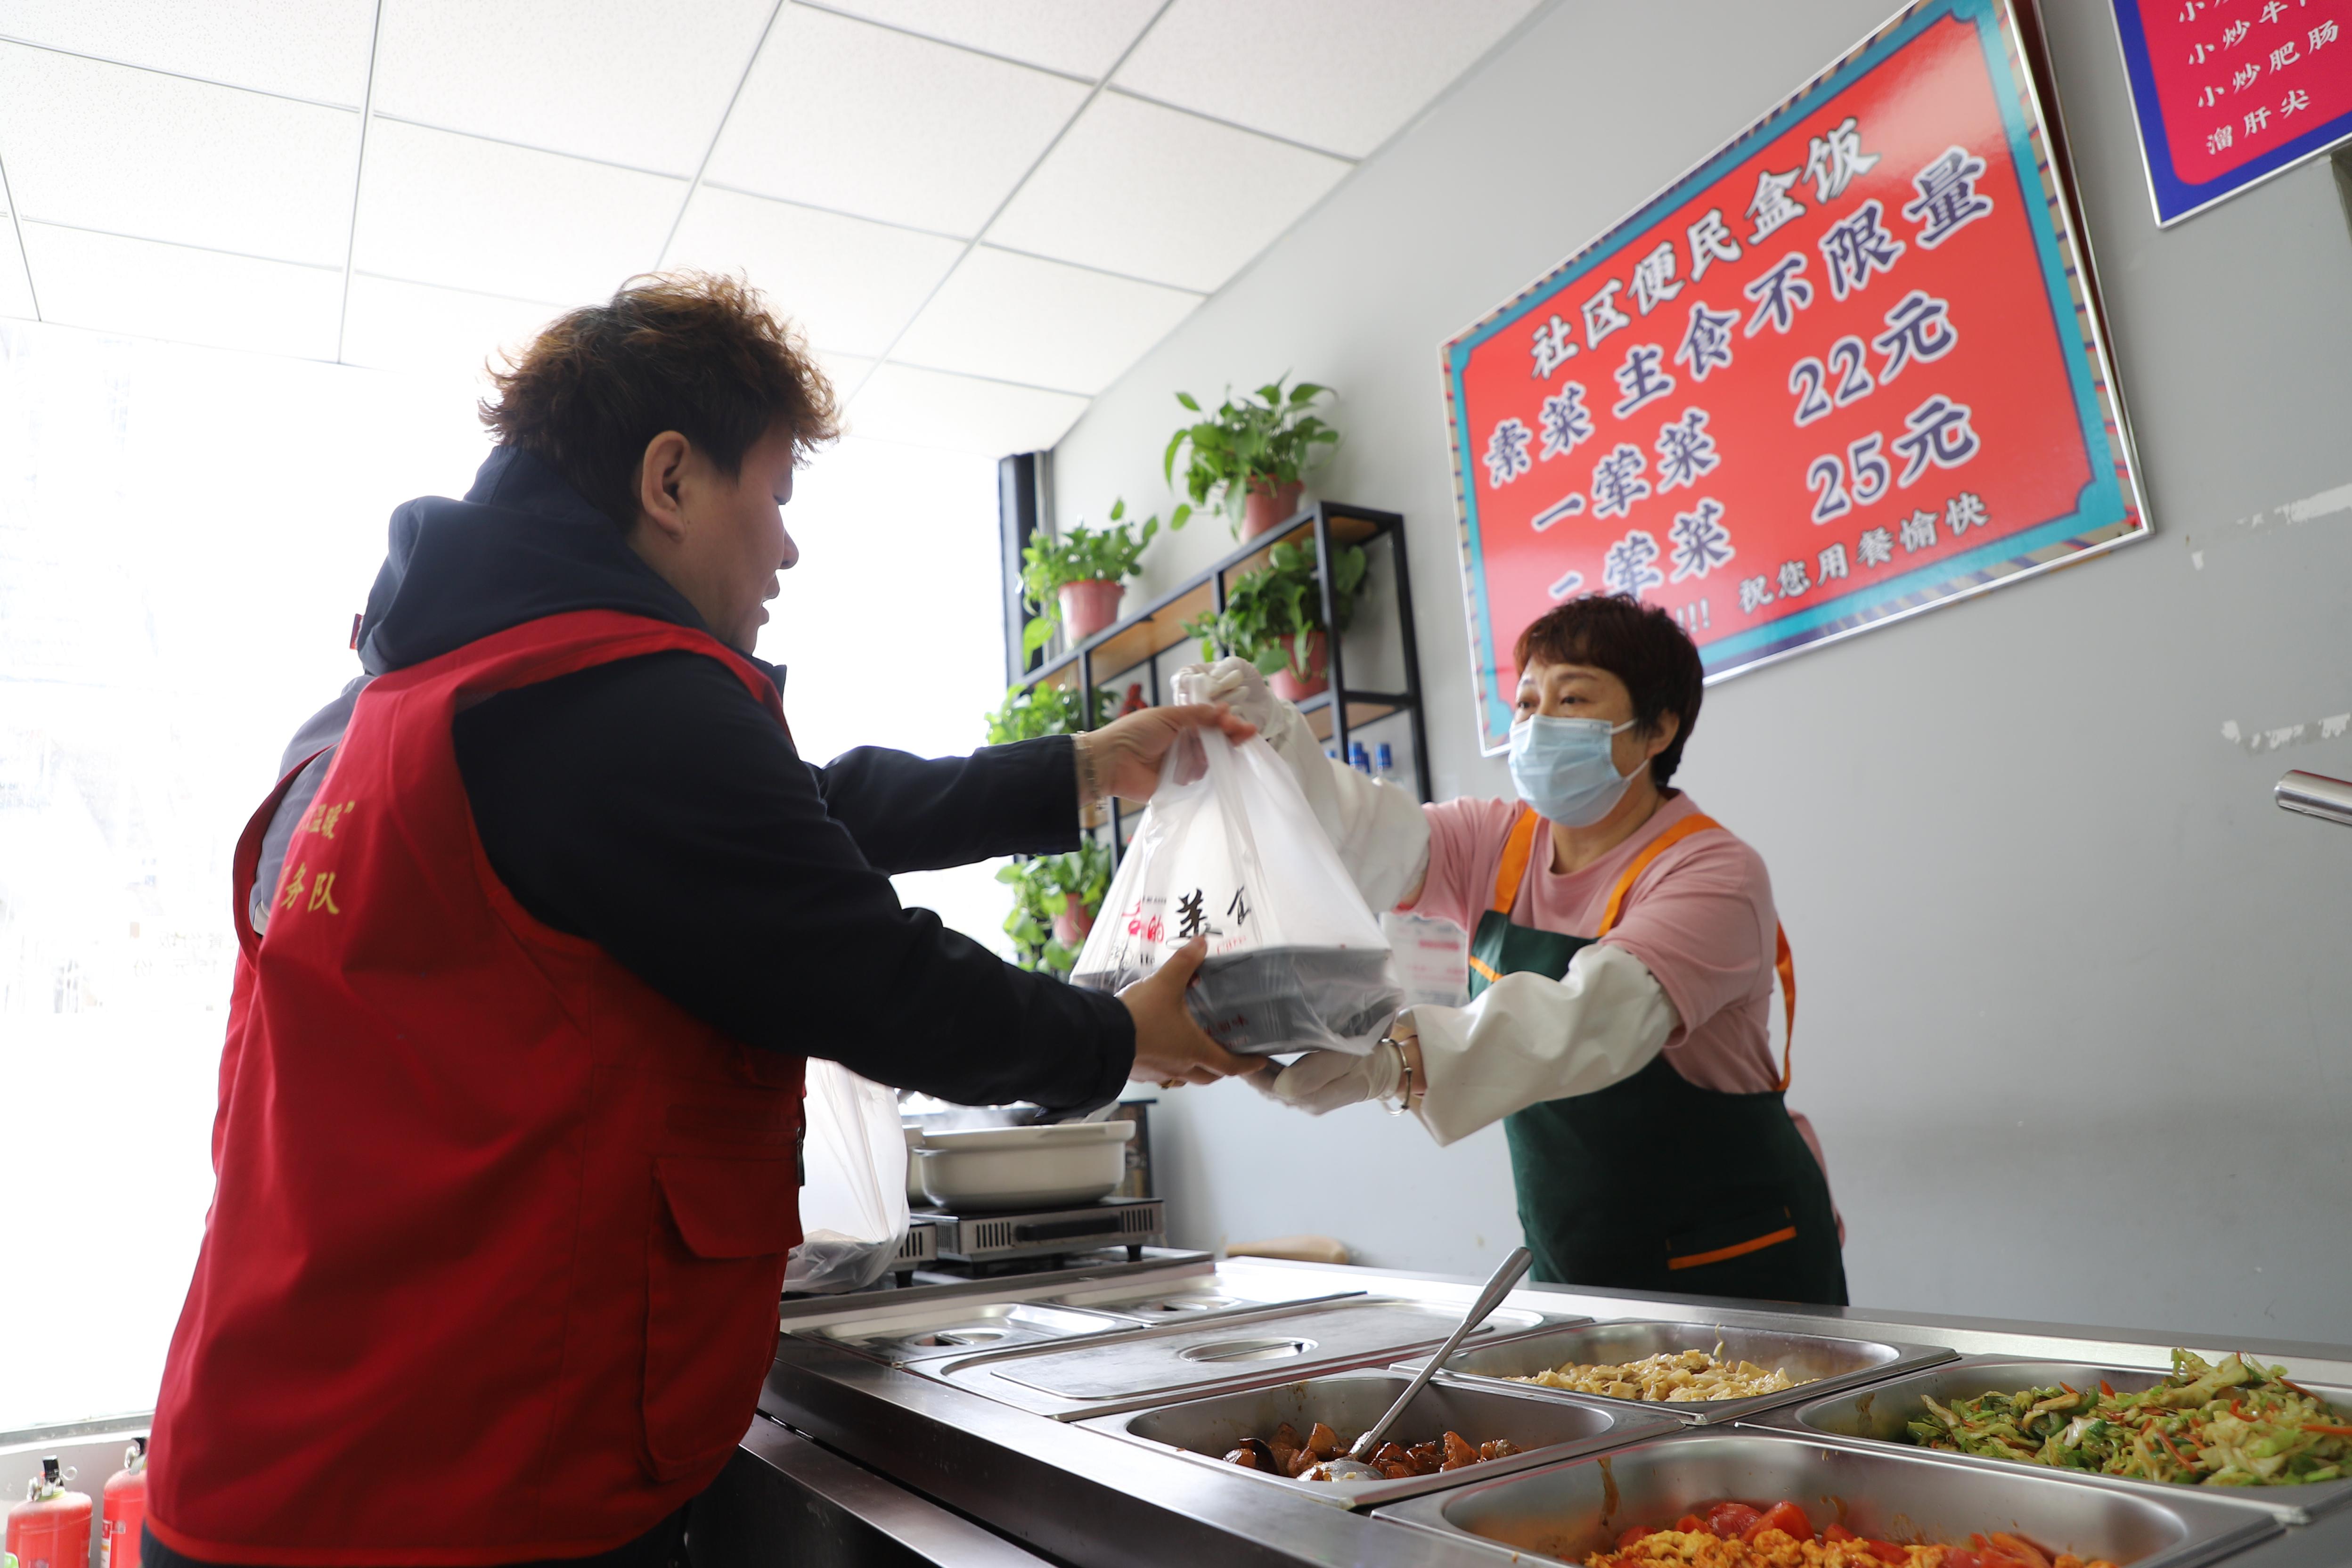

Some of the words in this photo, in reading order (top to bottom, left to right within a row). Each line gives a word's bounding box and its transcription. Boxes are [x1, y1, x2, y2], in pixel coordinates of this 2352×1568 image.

[2189, 0, 2307, 65] 小炒牛
[2198, 20, 2339, 108] 小炒肥肠
[2206, 89, 2311, 155] 溜肝尖
[1531, 116, 1882, 380] 社区便民盒饭
[1531, 406, 1721, 532] 一荤菜
[1788, 289, 1959, 427] 22元
[1805, 392, 1982, 526] 25元
[1739, 491, 1991, 615] 祝您用餐愉快
